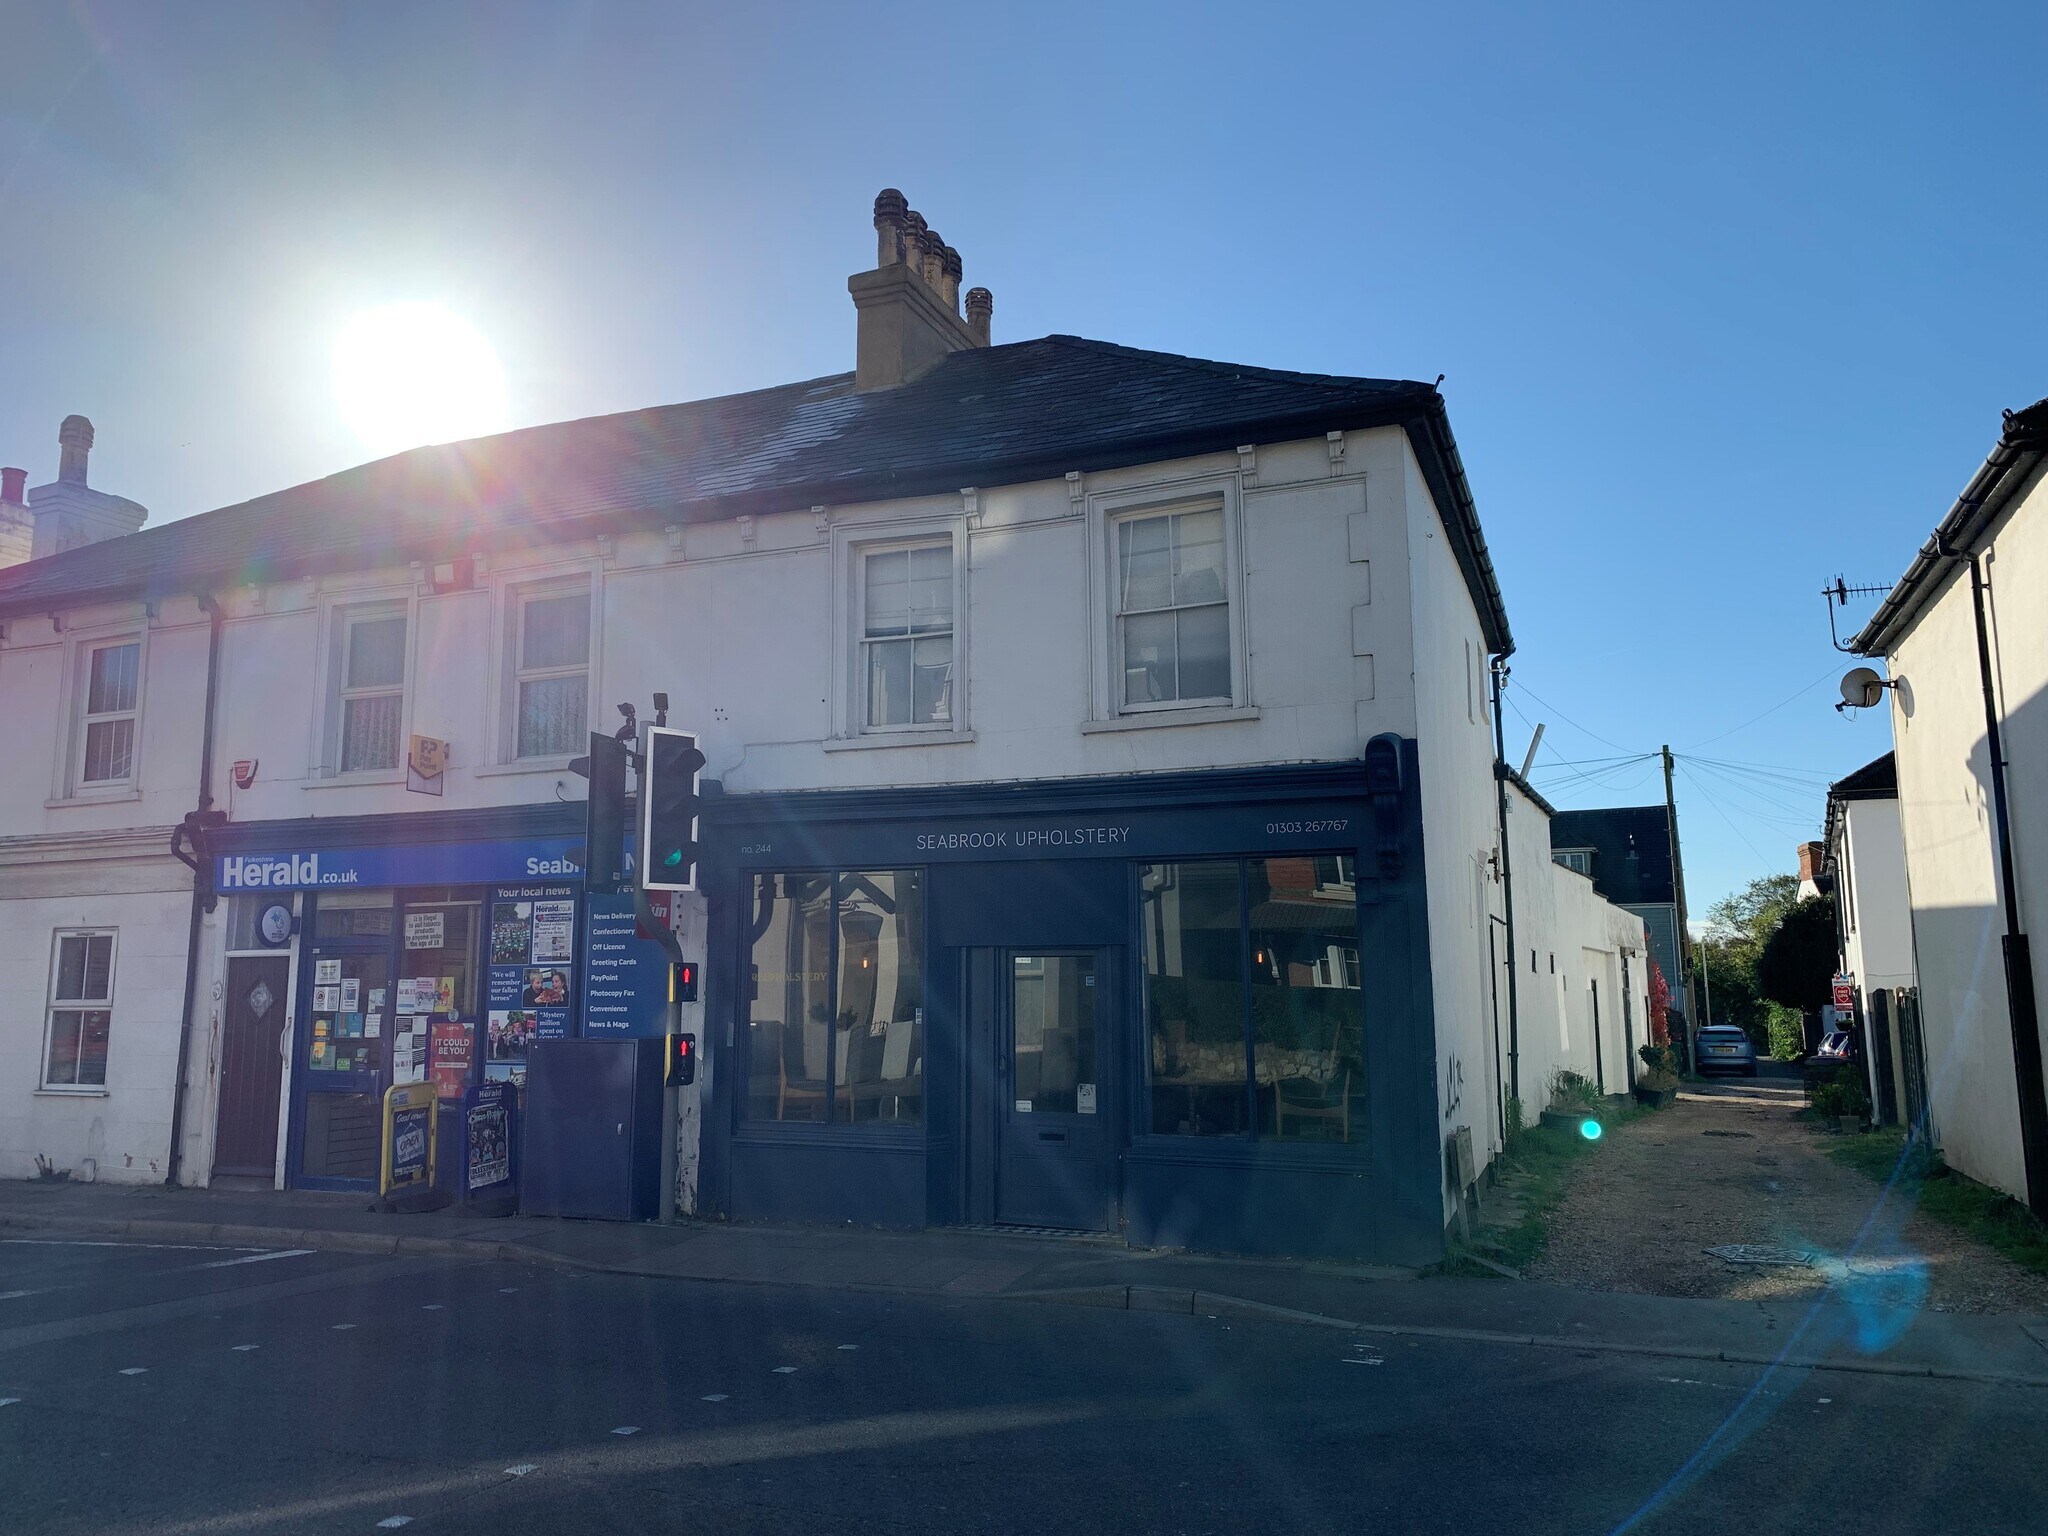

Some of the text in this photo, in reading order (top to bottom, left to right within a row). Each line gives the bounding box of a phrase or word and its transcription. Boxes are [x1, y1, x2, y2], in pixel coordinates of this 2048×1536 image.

[1266, 820, 1348, 834] 01303 267767
[916, 827, 1130, 849] SEABROOK UPHOLSTERY
[755, 843, 771, 854] 244
[497, 887, 571, 897] Your local news
[611, 912, 637, 920] Delivery
[591, 959, 618, 967] Greeting
[590, 974, 618, 982] PayPoint
[590, 989, 622, 998] Photocopy
[589, 1020, 630, 1029] News & Mags
[539, 1028, 555, 1036] spent
[435, 1038, 442, 1046] IT
[443, 1038, 470, 1046] COULD
[438, 1046, 466, 1055] BE YOU
[479, 1089, 502, 1098] Herald
[396, 1113, 411, 1123] Good
[400, 1134, 420, 1152] OPEN
